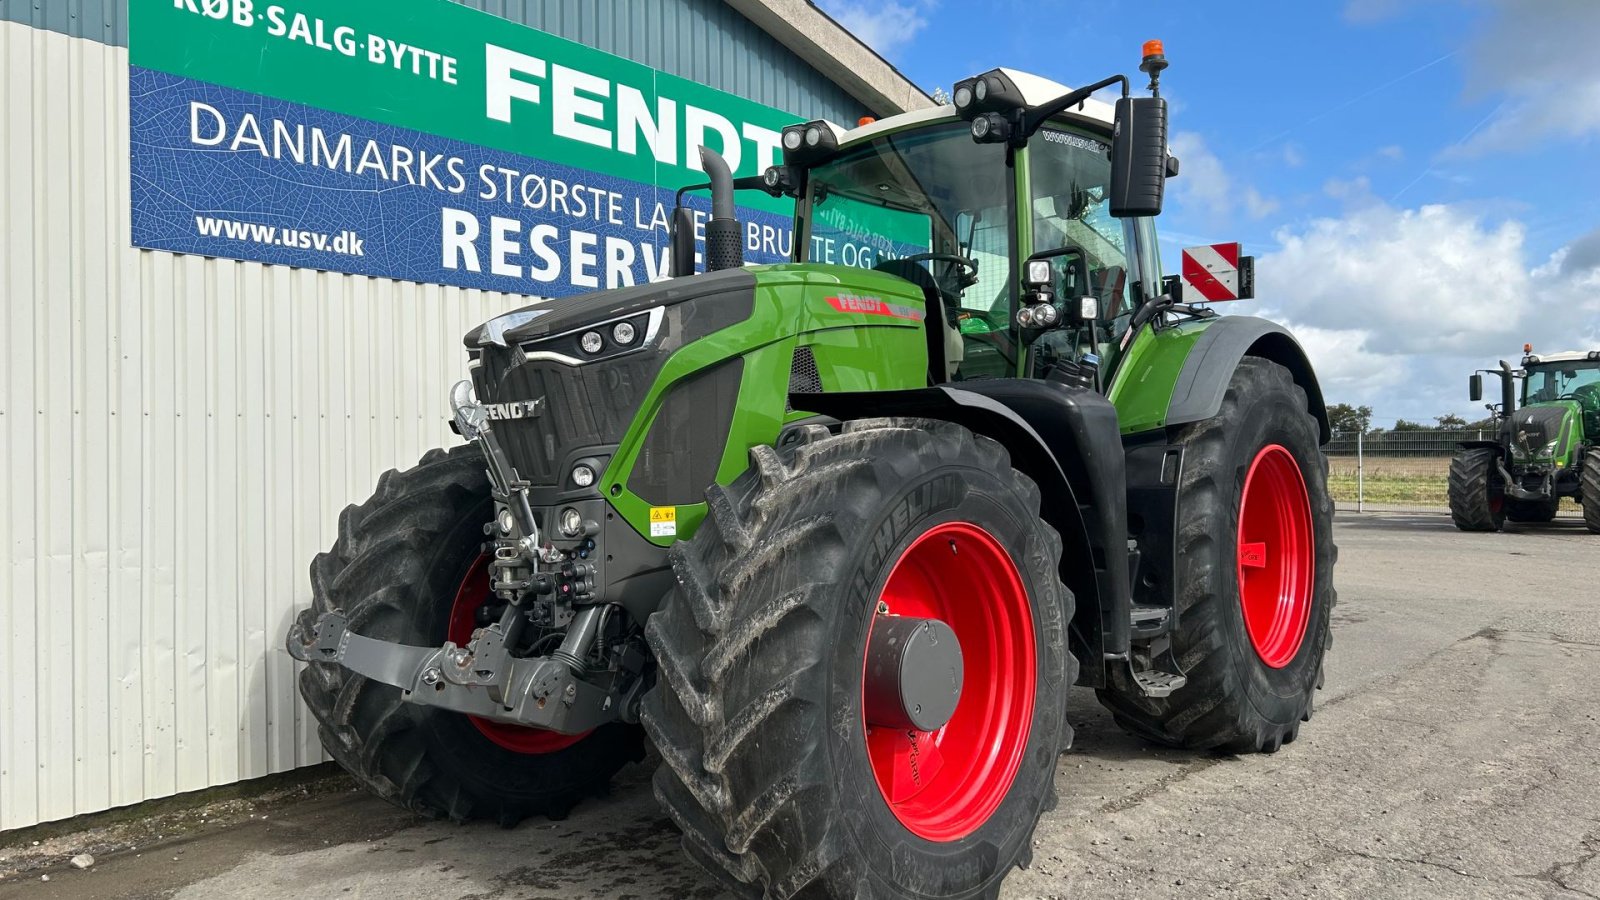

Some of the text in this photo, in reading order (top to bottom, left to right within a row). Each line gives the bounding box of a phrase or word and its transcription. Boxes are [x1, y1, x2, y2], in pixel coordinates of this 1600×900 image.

[485, 43, 784, 176] FENDT
[190, 101, 871, 270] DANMARKS STØRSTE LAE BRUTE OG
[196, 216, 364, 256] www.usv.dk
[837, 292, 881, 312] FENDT
